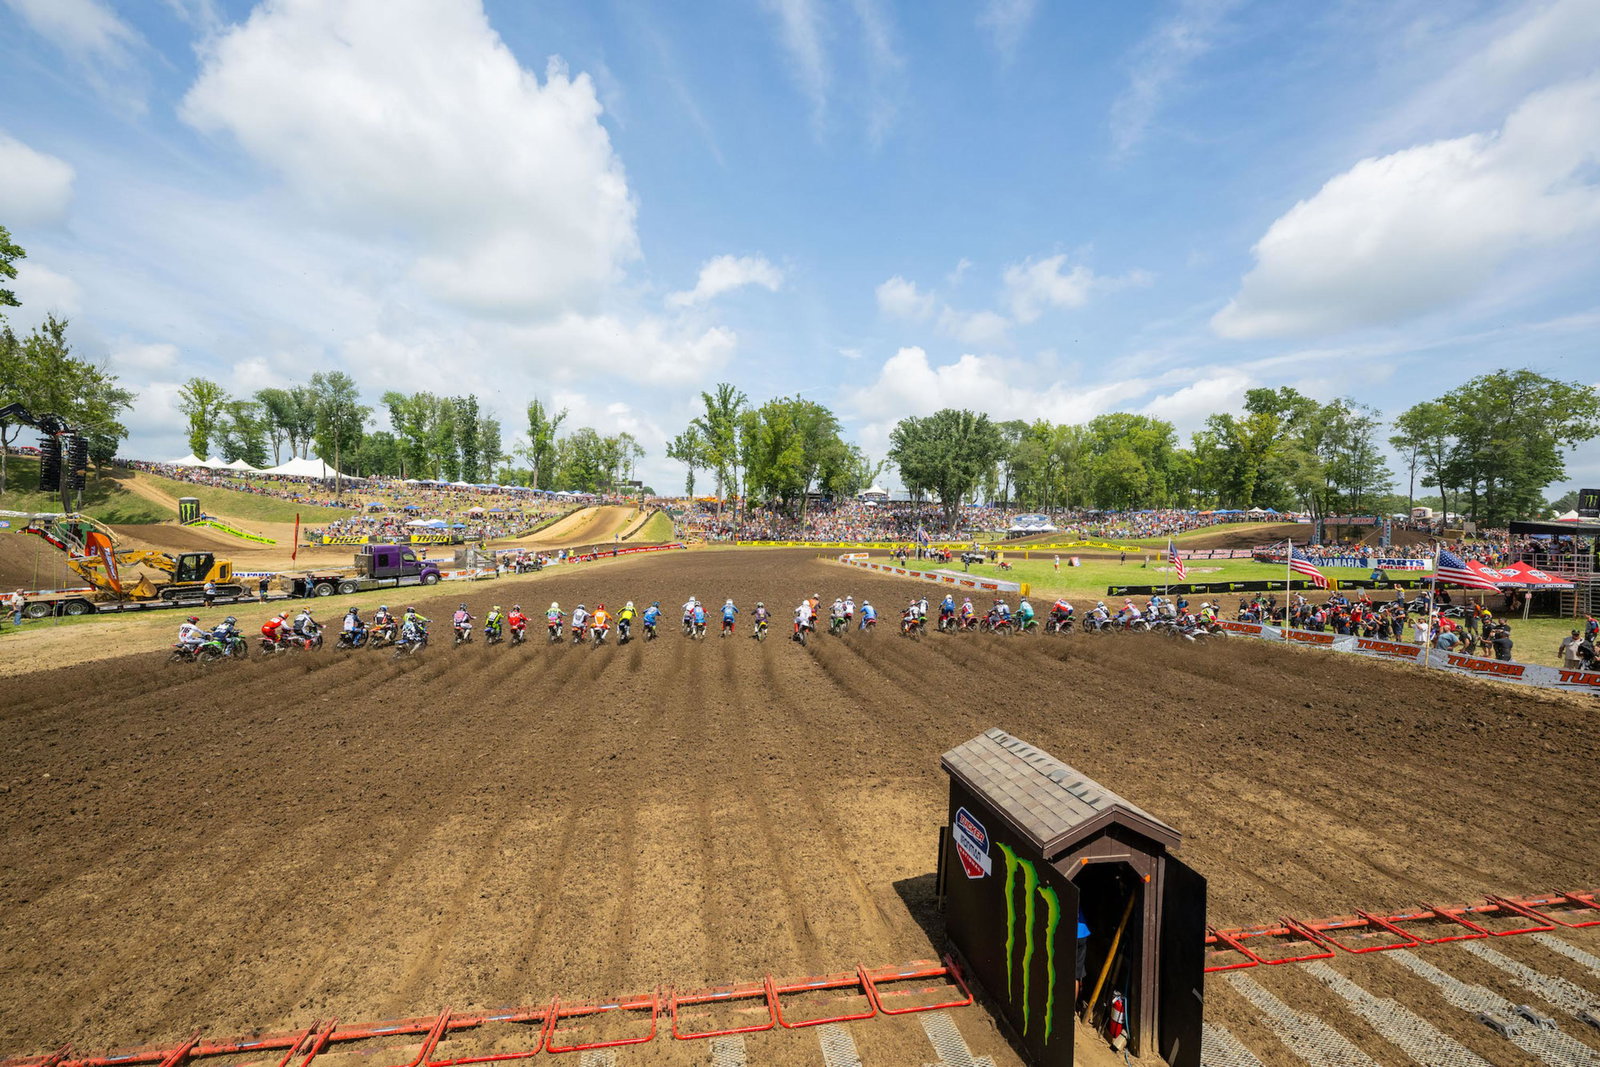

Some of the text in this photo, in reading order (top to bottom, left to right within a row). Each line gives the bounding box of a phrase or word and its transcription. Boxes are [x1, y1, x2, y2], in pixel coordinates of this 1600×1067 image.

[1323, 558, 1361, 569] YAMAHA
[1377, 559, 1424, 567] PARTS
[1357, 638, 1421, 657] TUCKER
[1447, 654, 1525, 676] TUCKER
[960, 813, 984, 842] TUCKER
